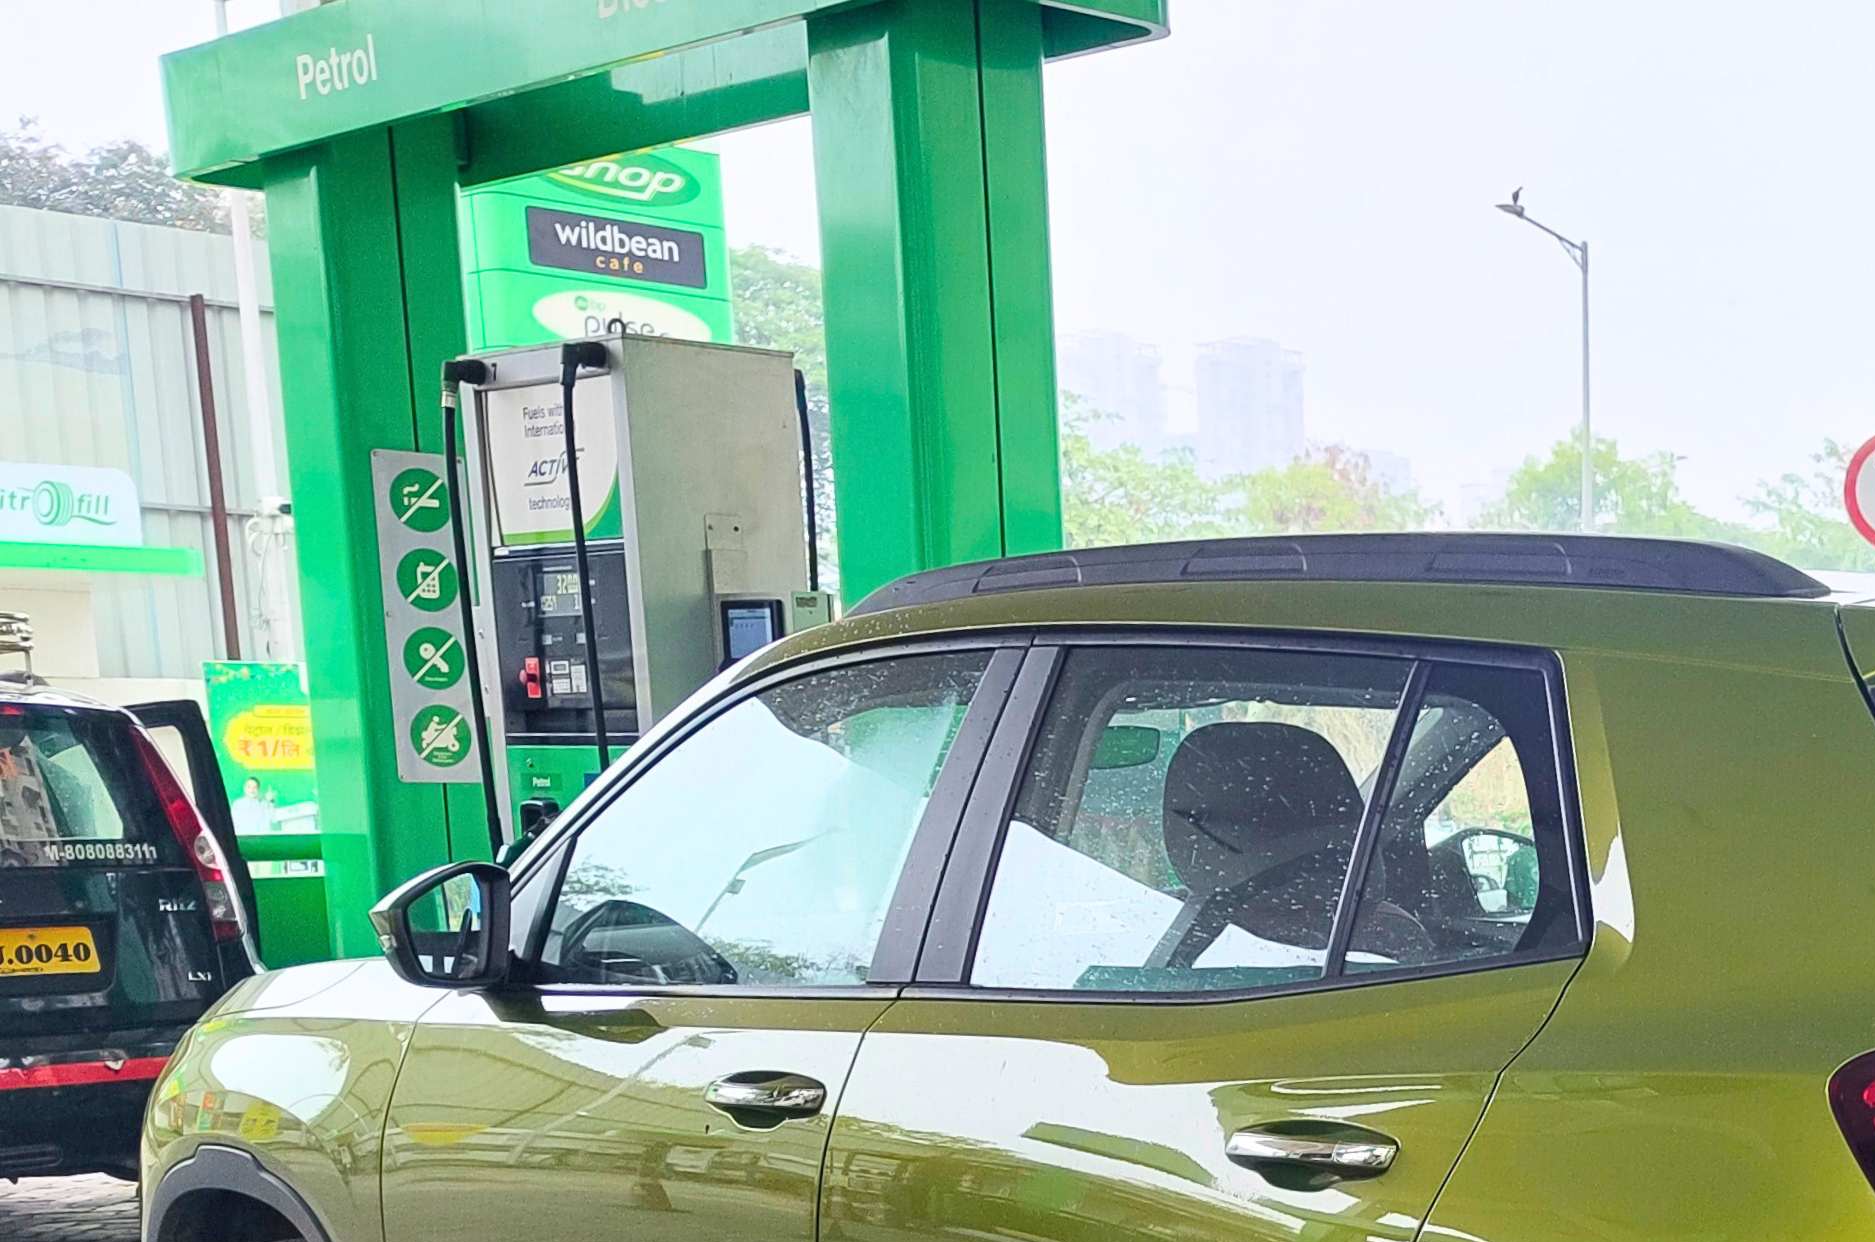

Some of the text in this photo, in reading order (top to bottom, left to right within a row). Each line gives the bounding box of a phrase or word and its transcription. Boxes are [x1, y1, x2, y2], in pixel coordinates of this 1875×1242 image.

[295, 34, 377, 99] Petrol
[554, 220, 680, 262] wildbean
[595, 255, 644, 274] cafe
[523, 406, 546, 420] Fuels
